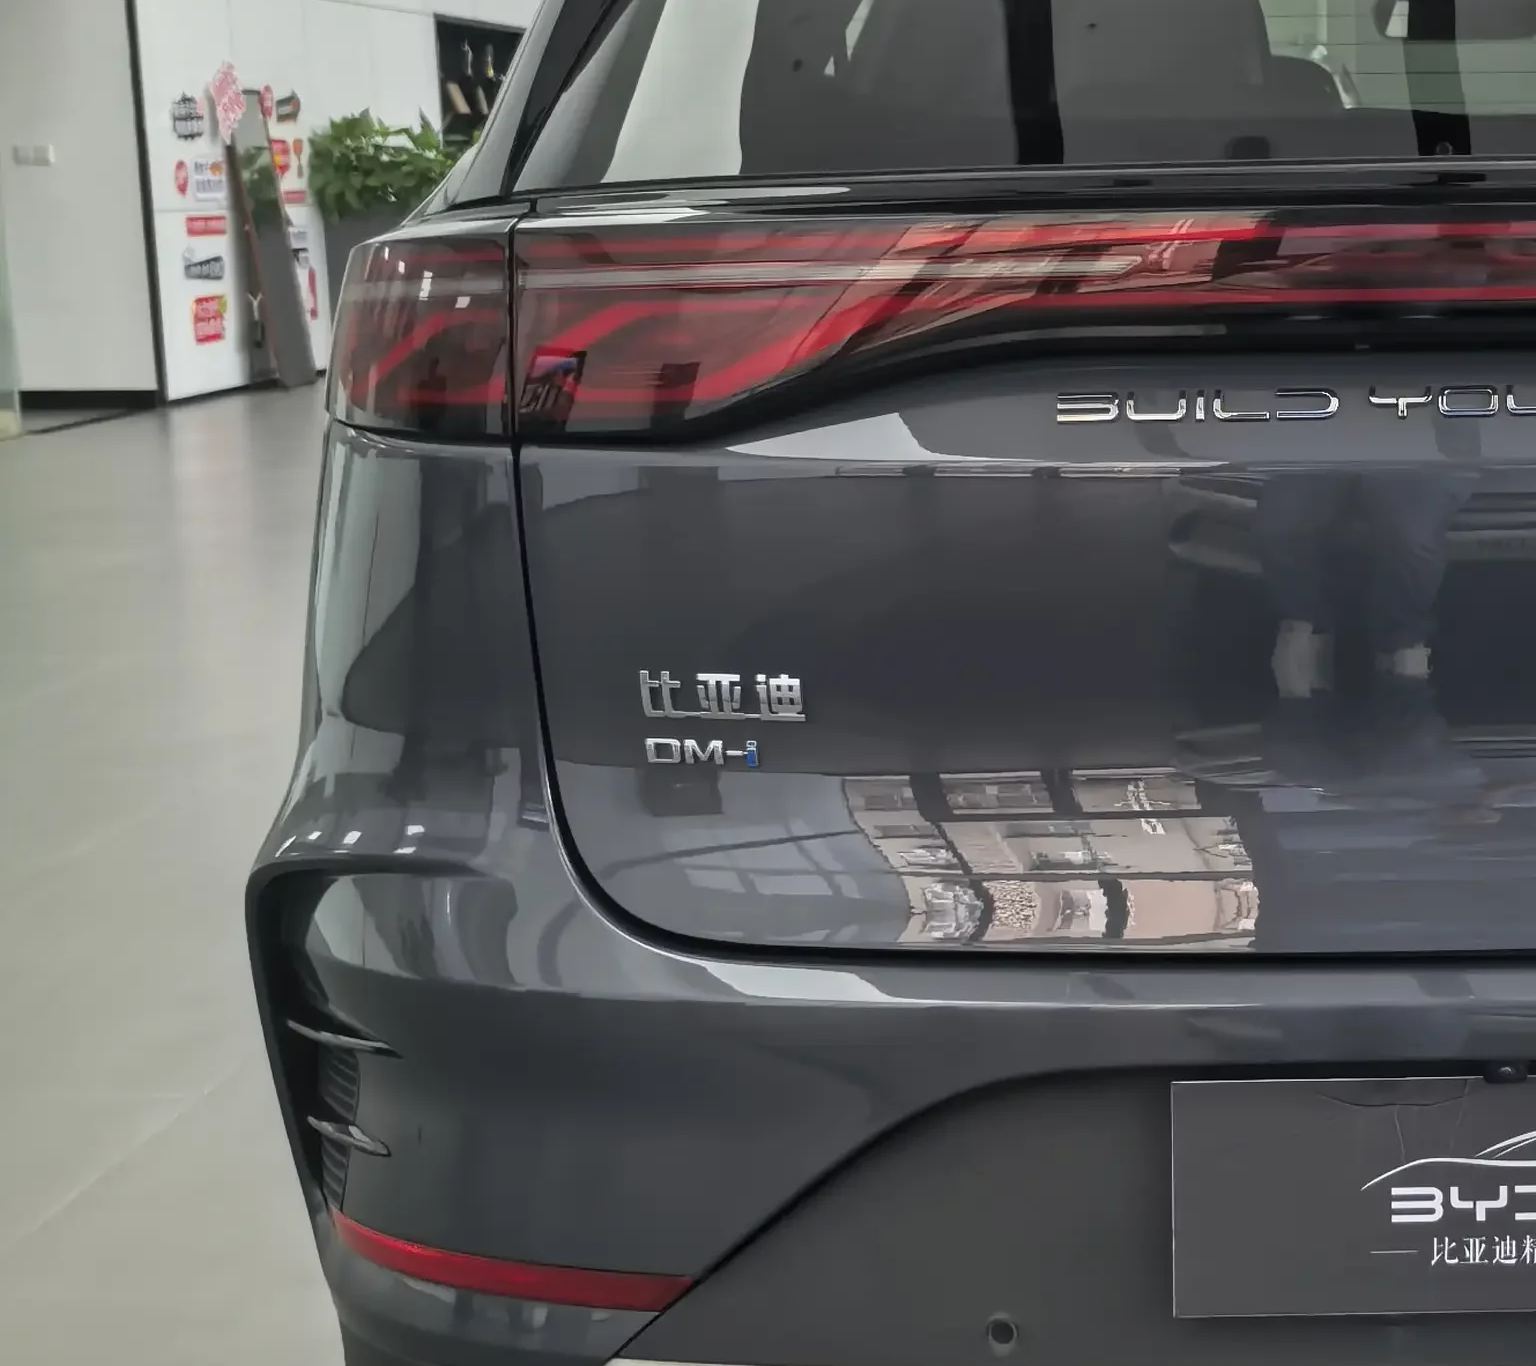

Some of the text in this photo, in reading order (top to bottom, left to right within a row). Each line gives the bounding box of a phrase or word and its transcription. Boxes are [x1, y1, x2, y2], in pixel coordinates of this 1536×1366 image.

[1056, 389, 1341, 423] BUILD
[639, 669, 806, 722] 比亚迪
[645, 737, 759, 767] DM-i
